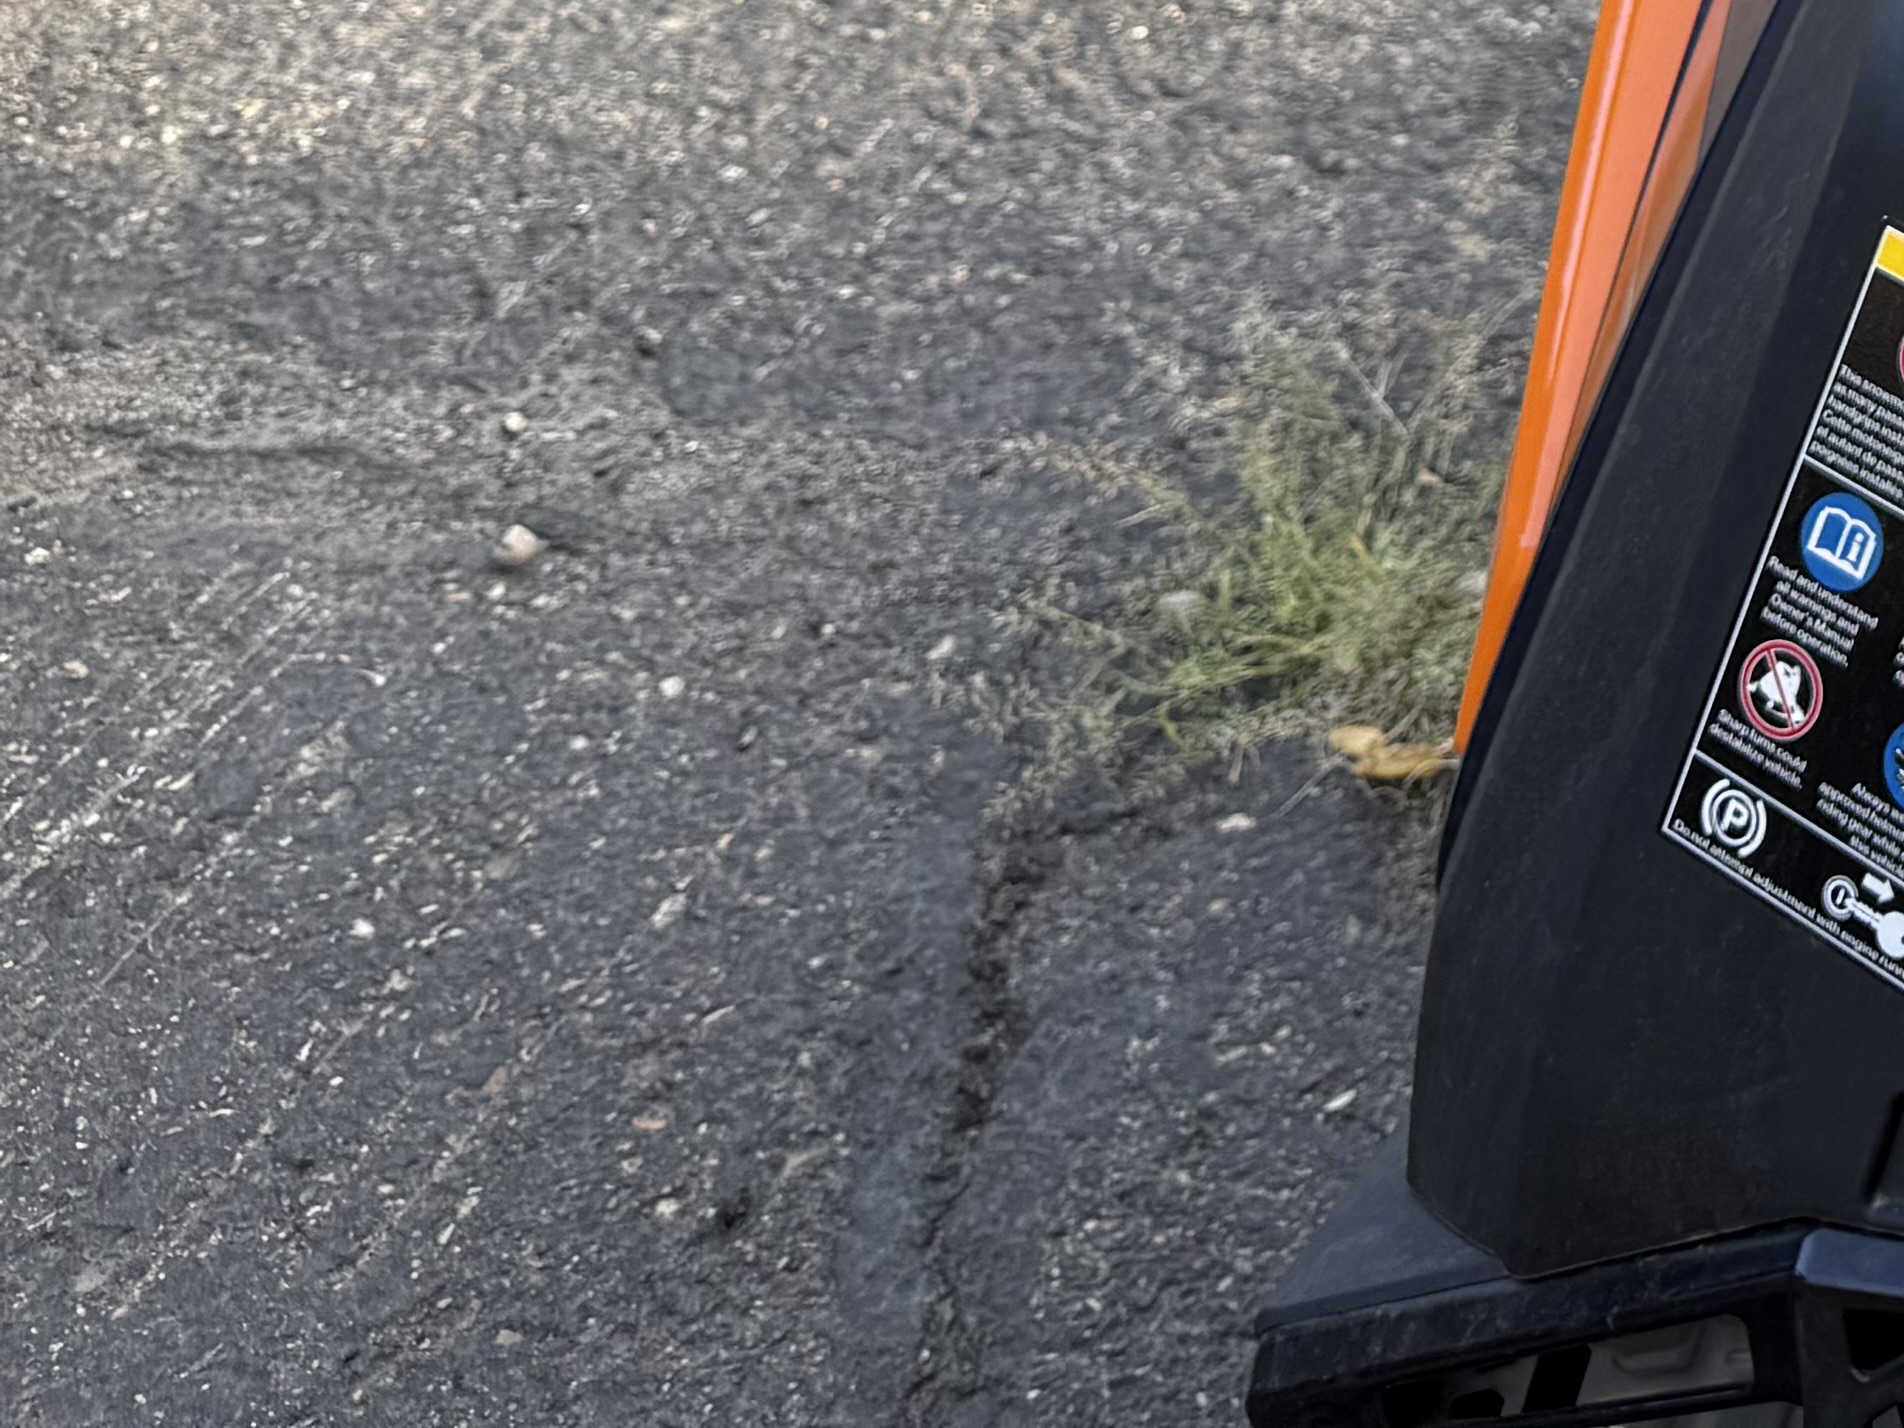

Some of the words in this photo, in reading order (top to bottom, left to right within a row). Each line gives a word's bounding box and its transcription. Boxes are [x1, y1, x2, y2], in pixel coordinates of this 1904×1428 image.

[1846, 388, 1877, 413] many
[1767, 555, 1798, 580] Read
[1817, 586, 1878, 628] understand
[1789, 589, 1836, 622] warnings
[1761, 605, 1796, 634] before
[1796, 628, 1848, 666] operation.
[1813, 618, 1854, 649] Manual
[1718, 708, 1749, 735] Sharp
[1748, 728, 1775, 752] turns
[1776, 747, 1807, 772] could
[1818, 782, 1870, 818] approved
[1851, 782, 1889, 813] Always
[1816, 798, 1848, 825] riding
[1872, 833, 1900, 856] while
[1709, 844, 1753, 877] attempt
[1752, 873, 1815, 919] adjustment
[1840, 930, 1882, 960] engine
